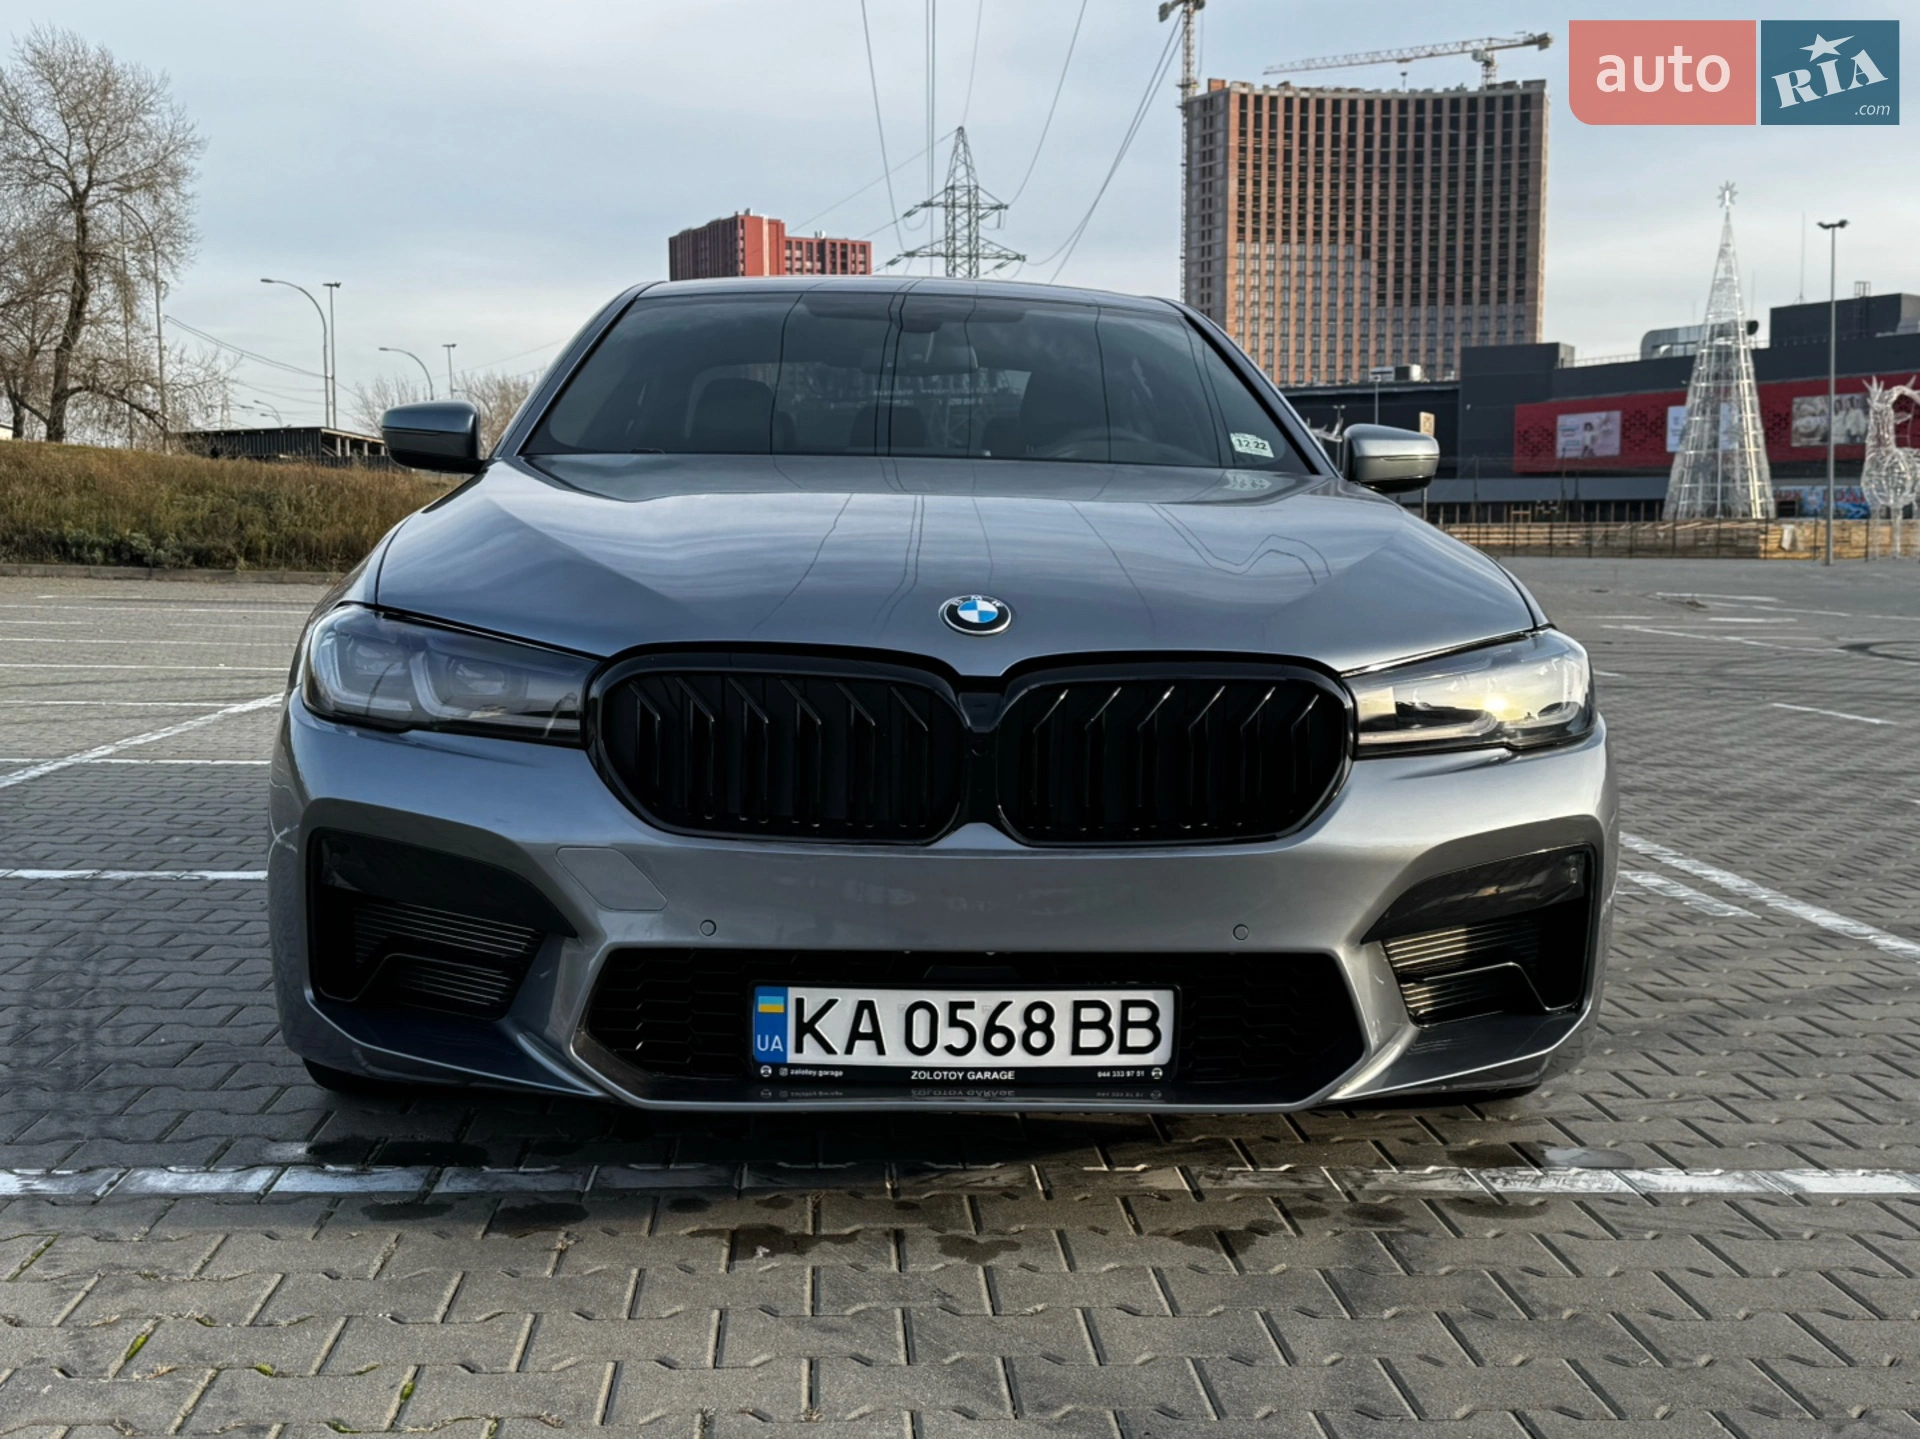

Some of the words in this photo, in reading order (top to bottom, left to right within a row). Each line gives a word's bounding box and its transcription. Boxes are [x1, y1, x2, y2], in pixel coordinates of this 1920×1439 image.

[794, 997, 886, 1056] KA
[904, 1000, 1055, 1057] 0568
[1071, 1000, 1162, 1056] BB
[757, 1035, 784, 1051] UA
[911, 1070, 965, 1080] ZOLOTOY
[967, 1070, 1015, 1080] GARAGE
